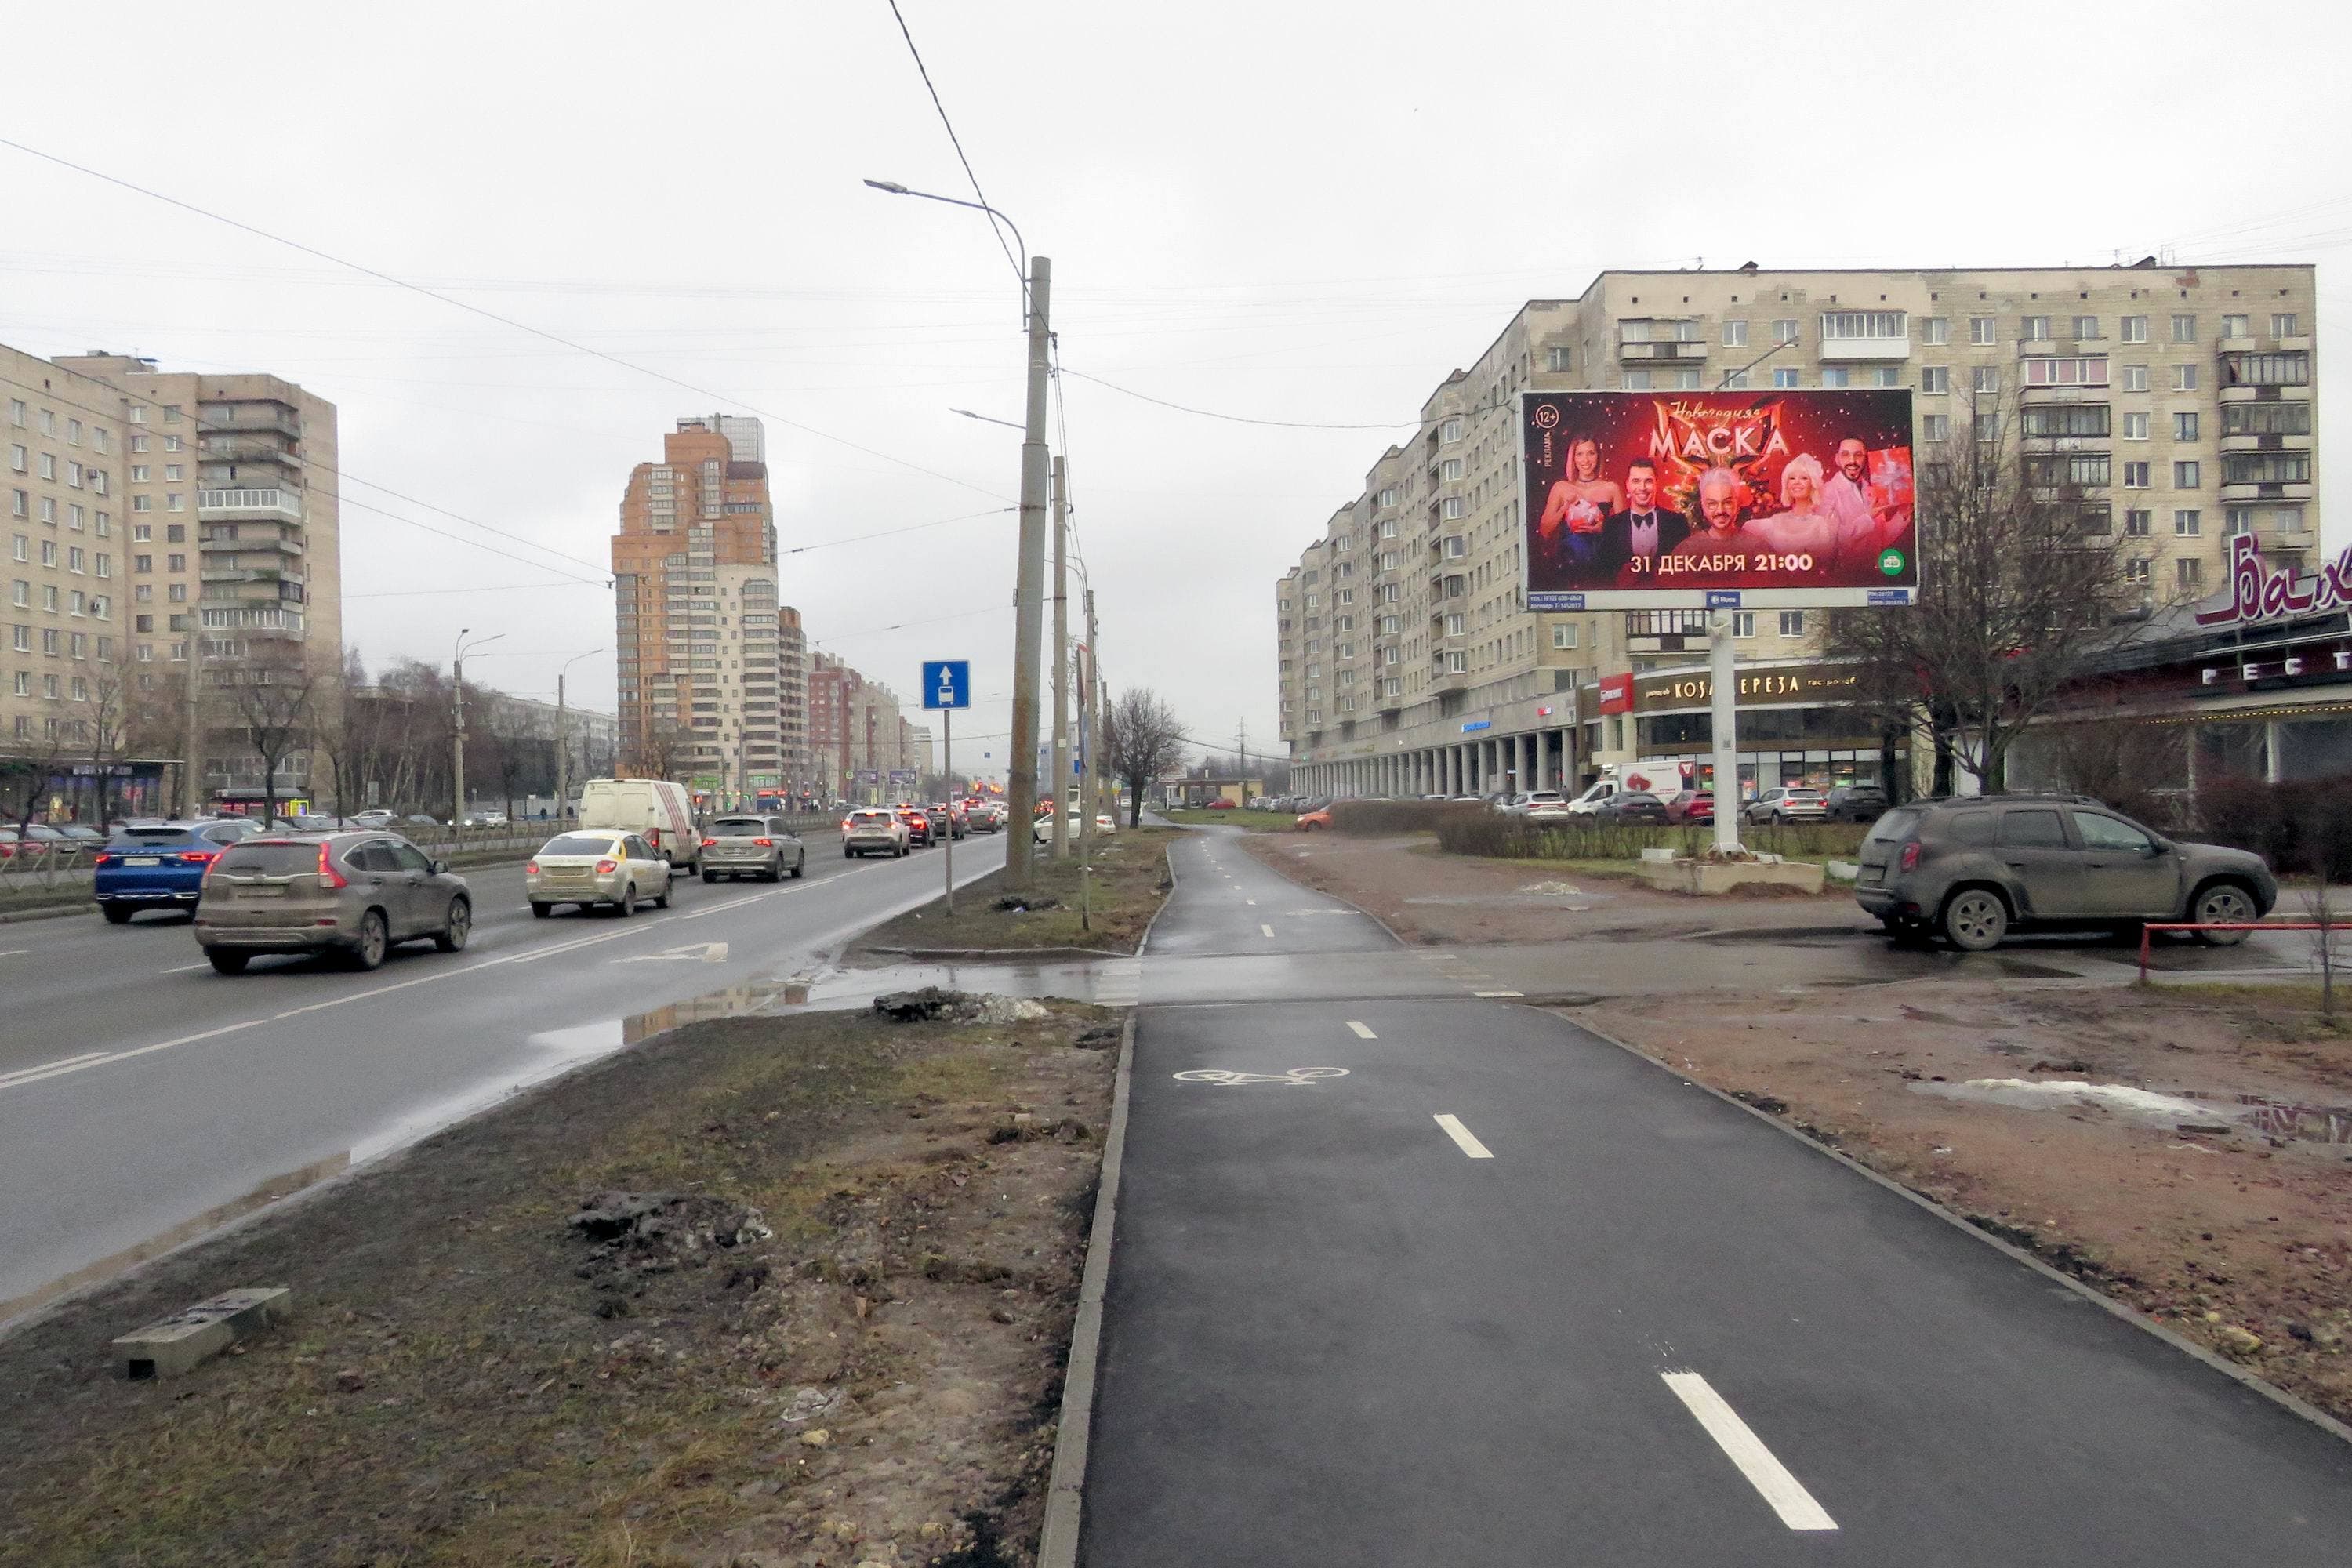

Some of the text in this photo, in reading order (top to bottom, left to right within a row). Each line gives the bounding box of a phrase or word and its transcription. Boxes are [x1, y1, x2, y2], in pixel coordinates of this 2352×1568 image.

[1539, 412, 1556, 423] 12+
[1648, 426, 1791, 460] МАСКА
[1630, 554, 1813, 575] 31 ДЕКАБРЯ 21:00
[1740, 676, 1798, 695] ЕРЕЗА
